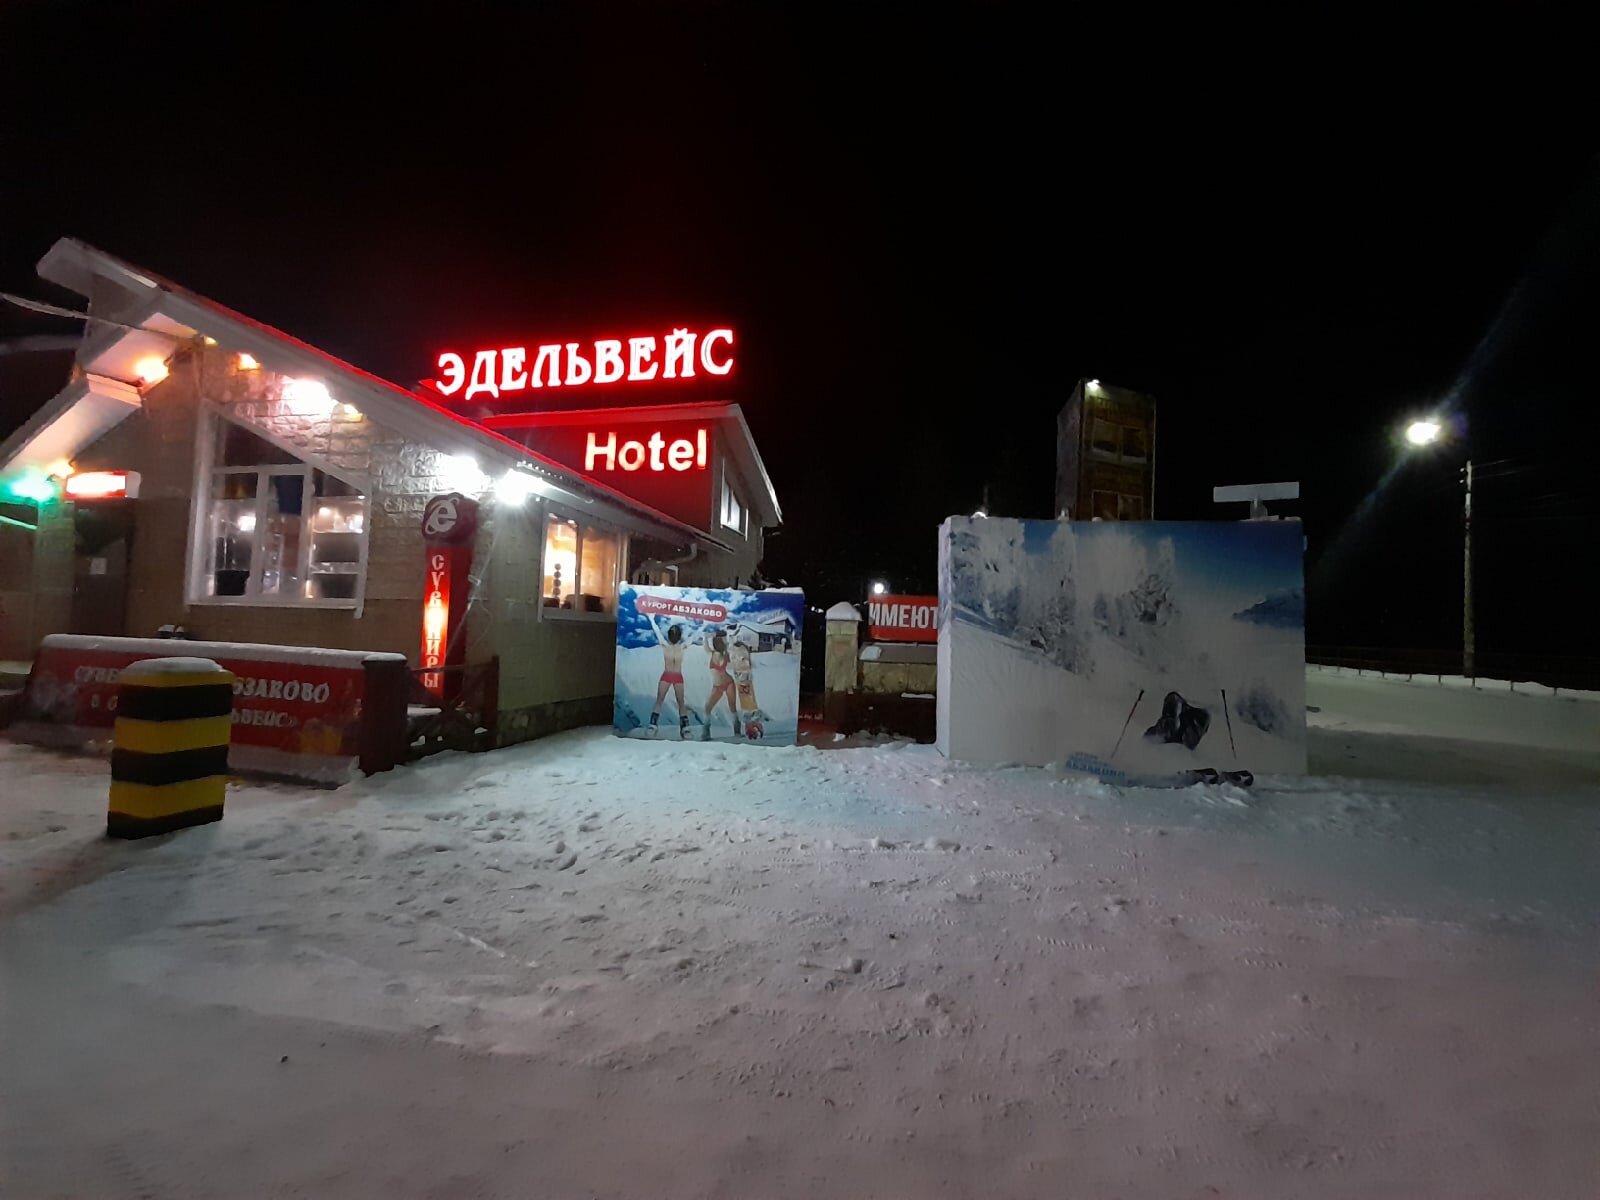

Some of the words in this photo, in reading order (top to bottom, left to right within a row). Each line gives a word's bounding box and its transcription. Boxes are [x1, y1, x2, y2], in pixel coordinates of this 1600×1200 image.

[436, 328, 734, 400] ЭДЕЛЬВЕЙС
[585, 428, 707, 472] Hotel
[424, 554, 445, 688] СУВИРЫ
[641, 600, 672, 610] КУРОРТ
[672, 604, 723, 618] АБЗАКОВО
[231, 677, 330, 704] БЗАКОВО
